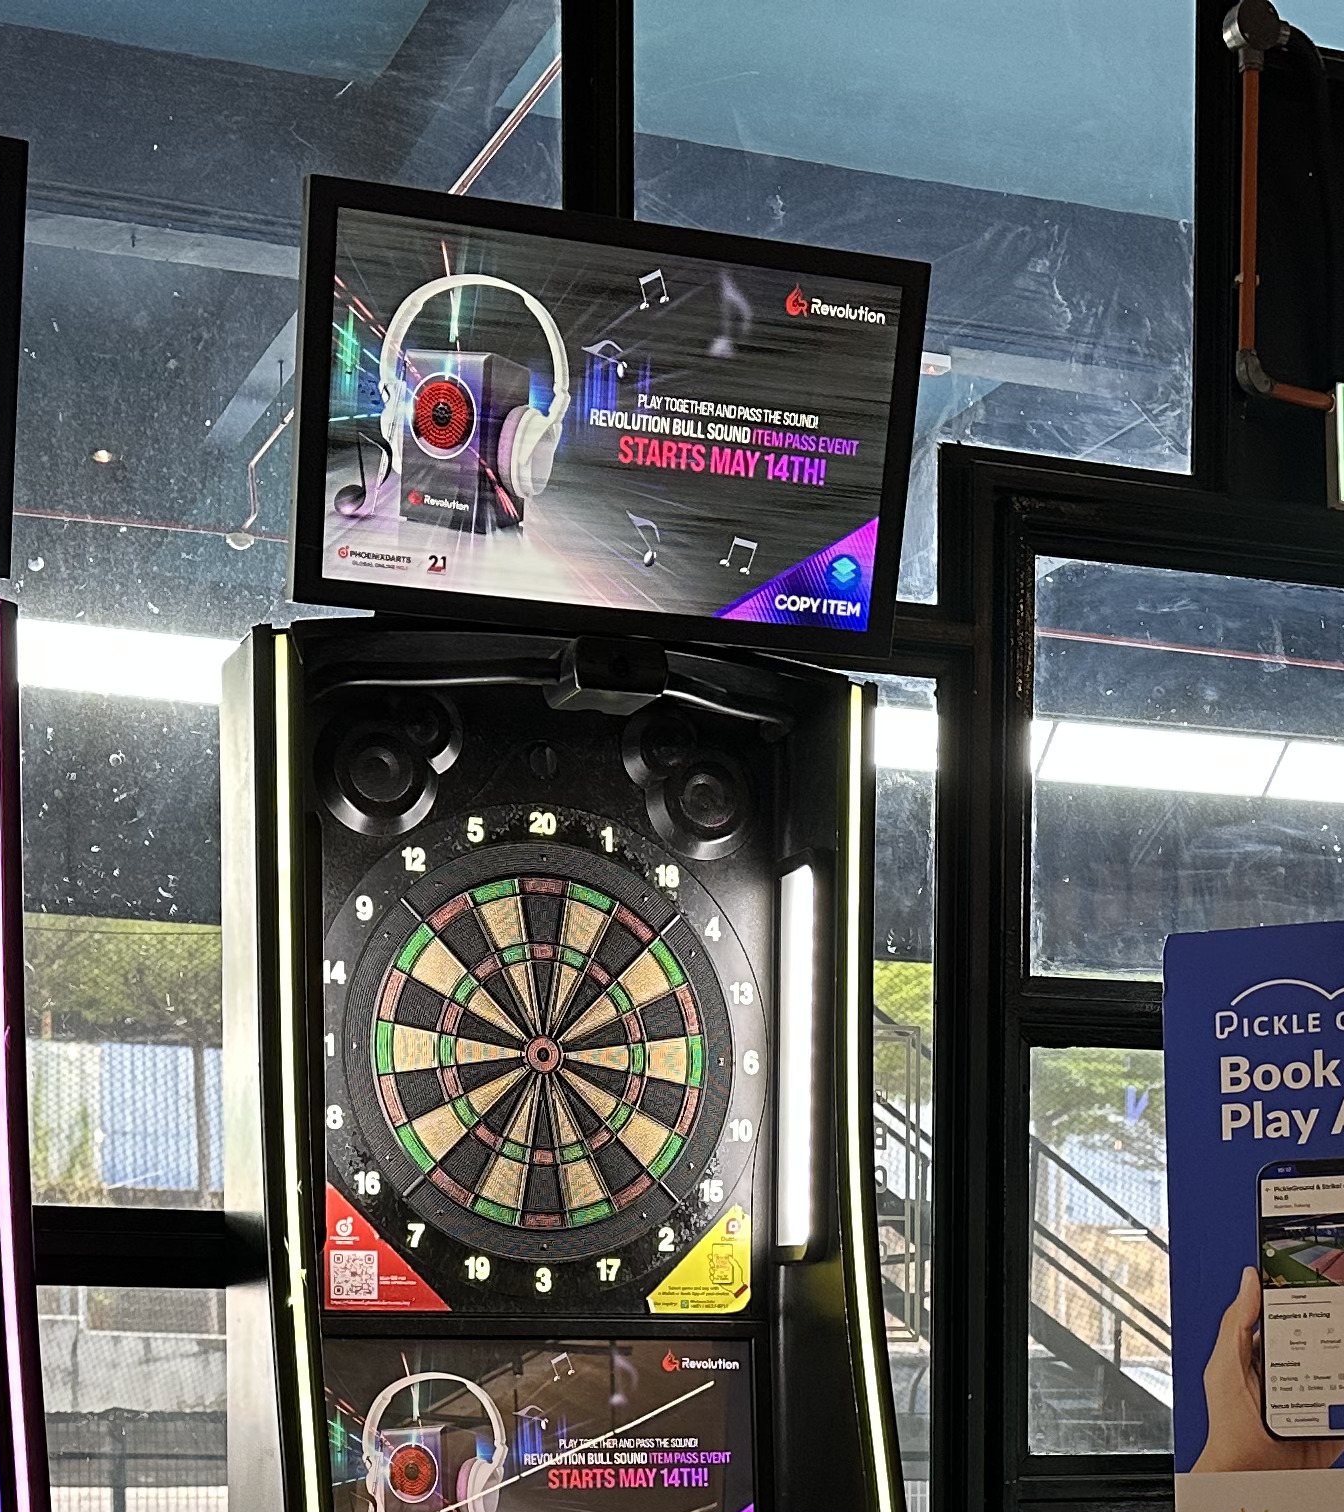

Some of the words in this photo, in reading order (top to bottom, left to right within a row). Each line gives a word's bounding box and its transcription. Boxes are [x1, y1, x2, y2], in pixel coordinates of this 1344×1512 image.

[810, 298, 886, 325] Revolution
[590, 408, 669, 435] REVOLUTION
[672, 417, 704, 439] BULL
[707, 422, 751, 445] SOUND
[752, 428, 786, 448] ITEM
[787, 433, 815, 453] PASS
[818, 437, 859, 457] EVENT
[618, 435, 705, 472] STARTS
[710, 446, 761, 479] MAY
[764, 453, 826, 486] 14TH!
[775, 593, 821, 613] COPY
[822, 599, 861, 617] ITEM
[529, 812, 556, 836] 20
[402, 847, 426, 872] 12
[1216, 1010, 1320, 1038] PICKLE
[1220, 1049, 1341, 1093] Book
[1221, 1101, 1319, 1144] Play
[535, 1268, 553, 1293] 3
[548, 1470, 615, 1490] STARTS
[619, 1469, 656, 1489] MAY
[660, 1468, 709, 1488] 14TH!
